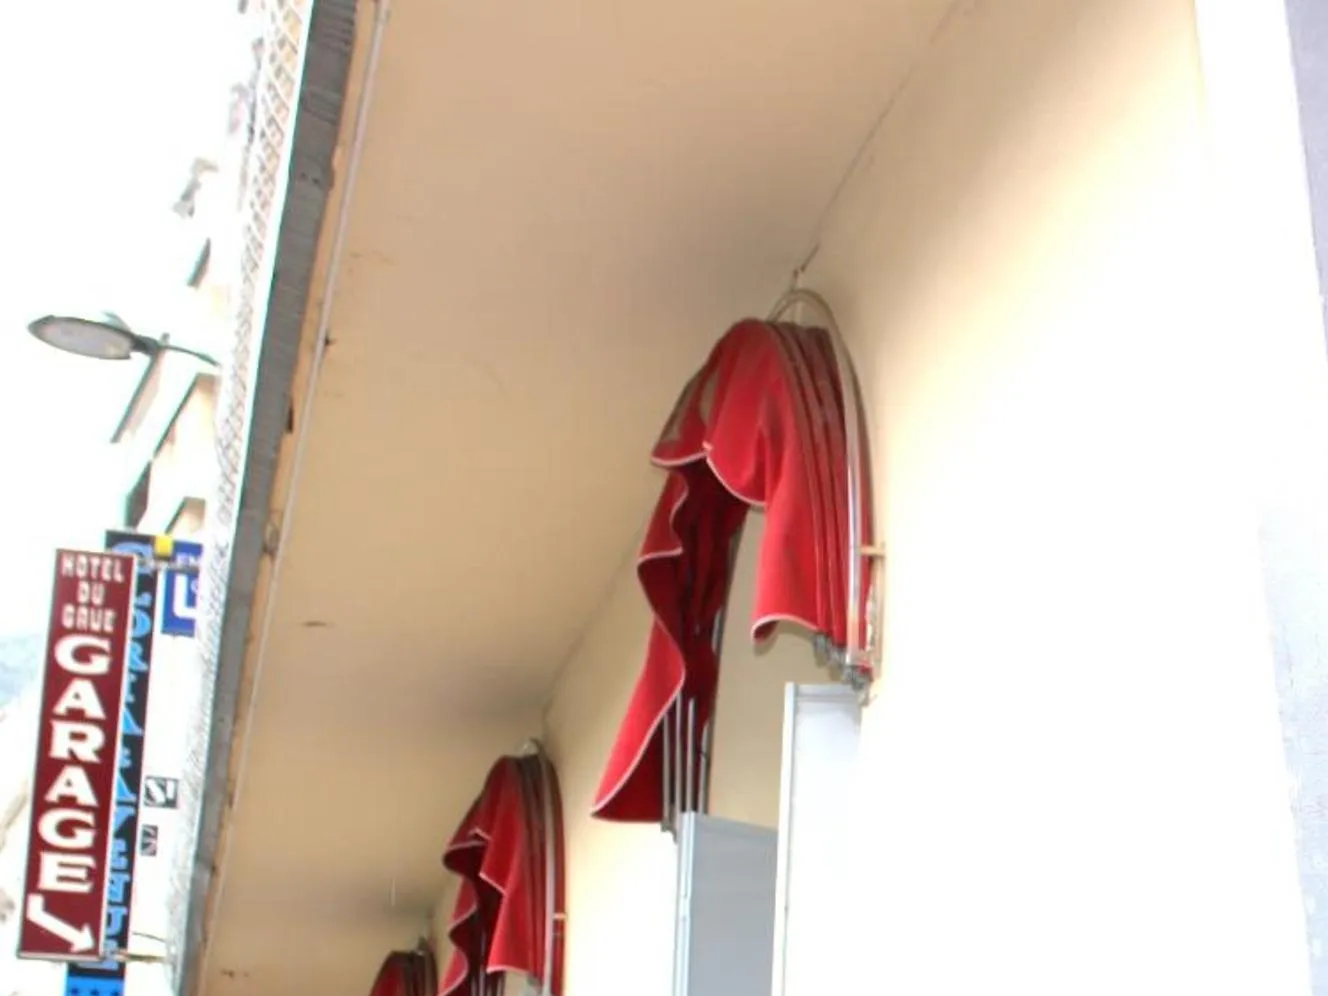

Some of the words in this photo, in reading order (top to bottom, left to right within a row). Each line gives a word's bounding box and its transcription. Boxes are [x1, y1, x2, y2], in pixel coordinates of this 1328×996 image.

[61, 552, 124, 584] HOTEL
[78, 580, 105, 606] DU
[38, 634, 112, 894] GARAGE
